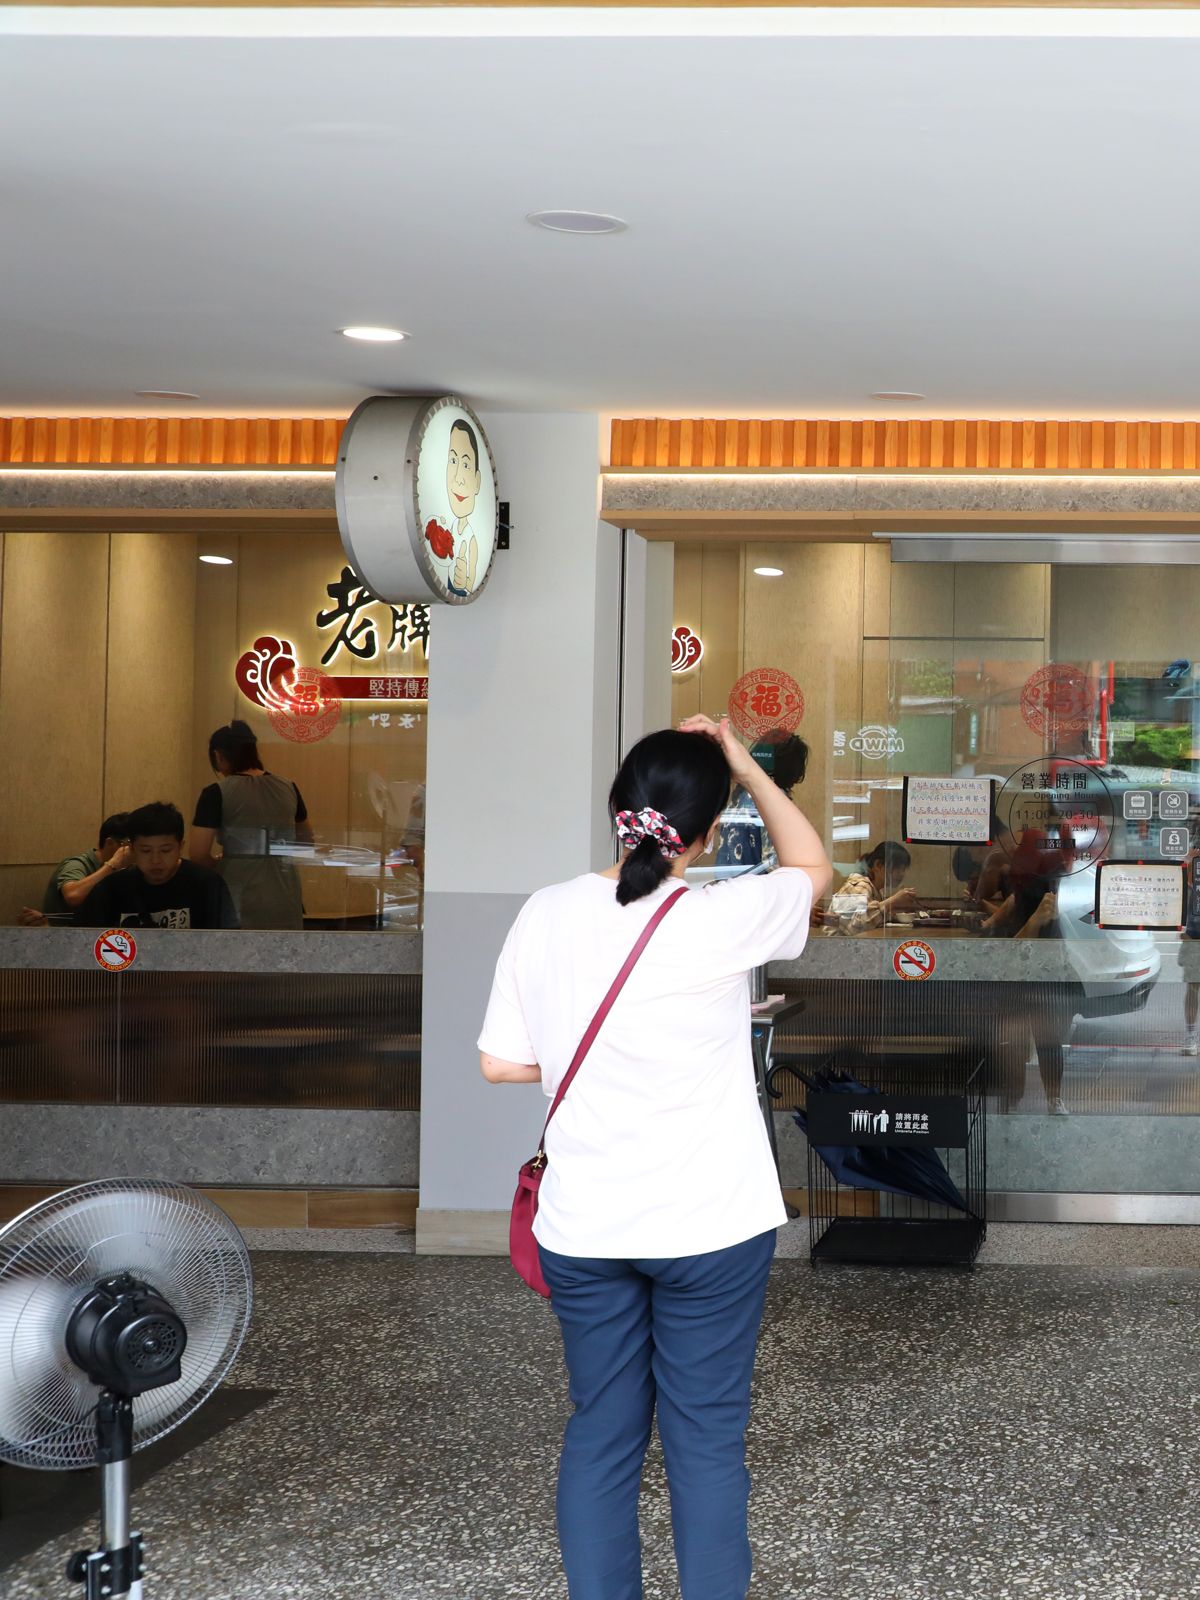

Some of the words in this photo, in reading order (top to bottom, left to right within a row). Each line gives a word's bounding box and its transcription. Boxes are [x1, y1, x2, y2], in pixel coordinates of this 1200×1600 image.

[750, 684, 782, 717] 福
[1021, 772, 1087, 790] 營業時間
[1033, 791, 1070, 800] Opening
[895, 1113, 928, 1121] 請將雨傘
[895, 1121, 929, 1130] 放置此處
